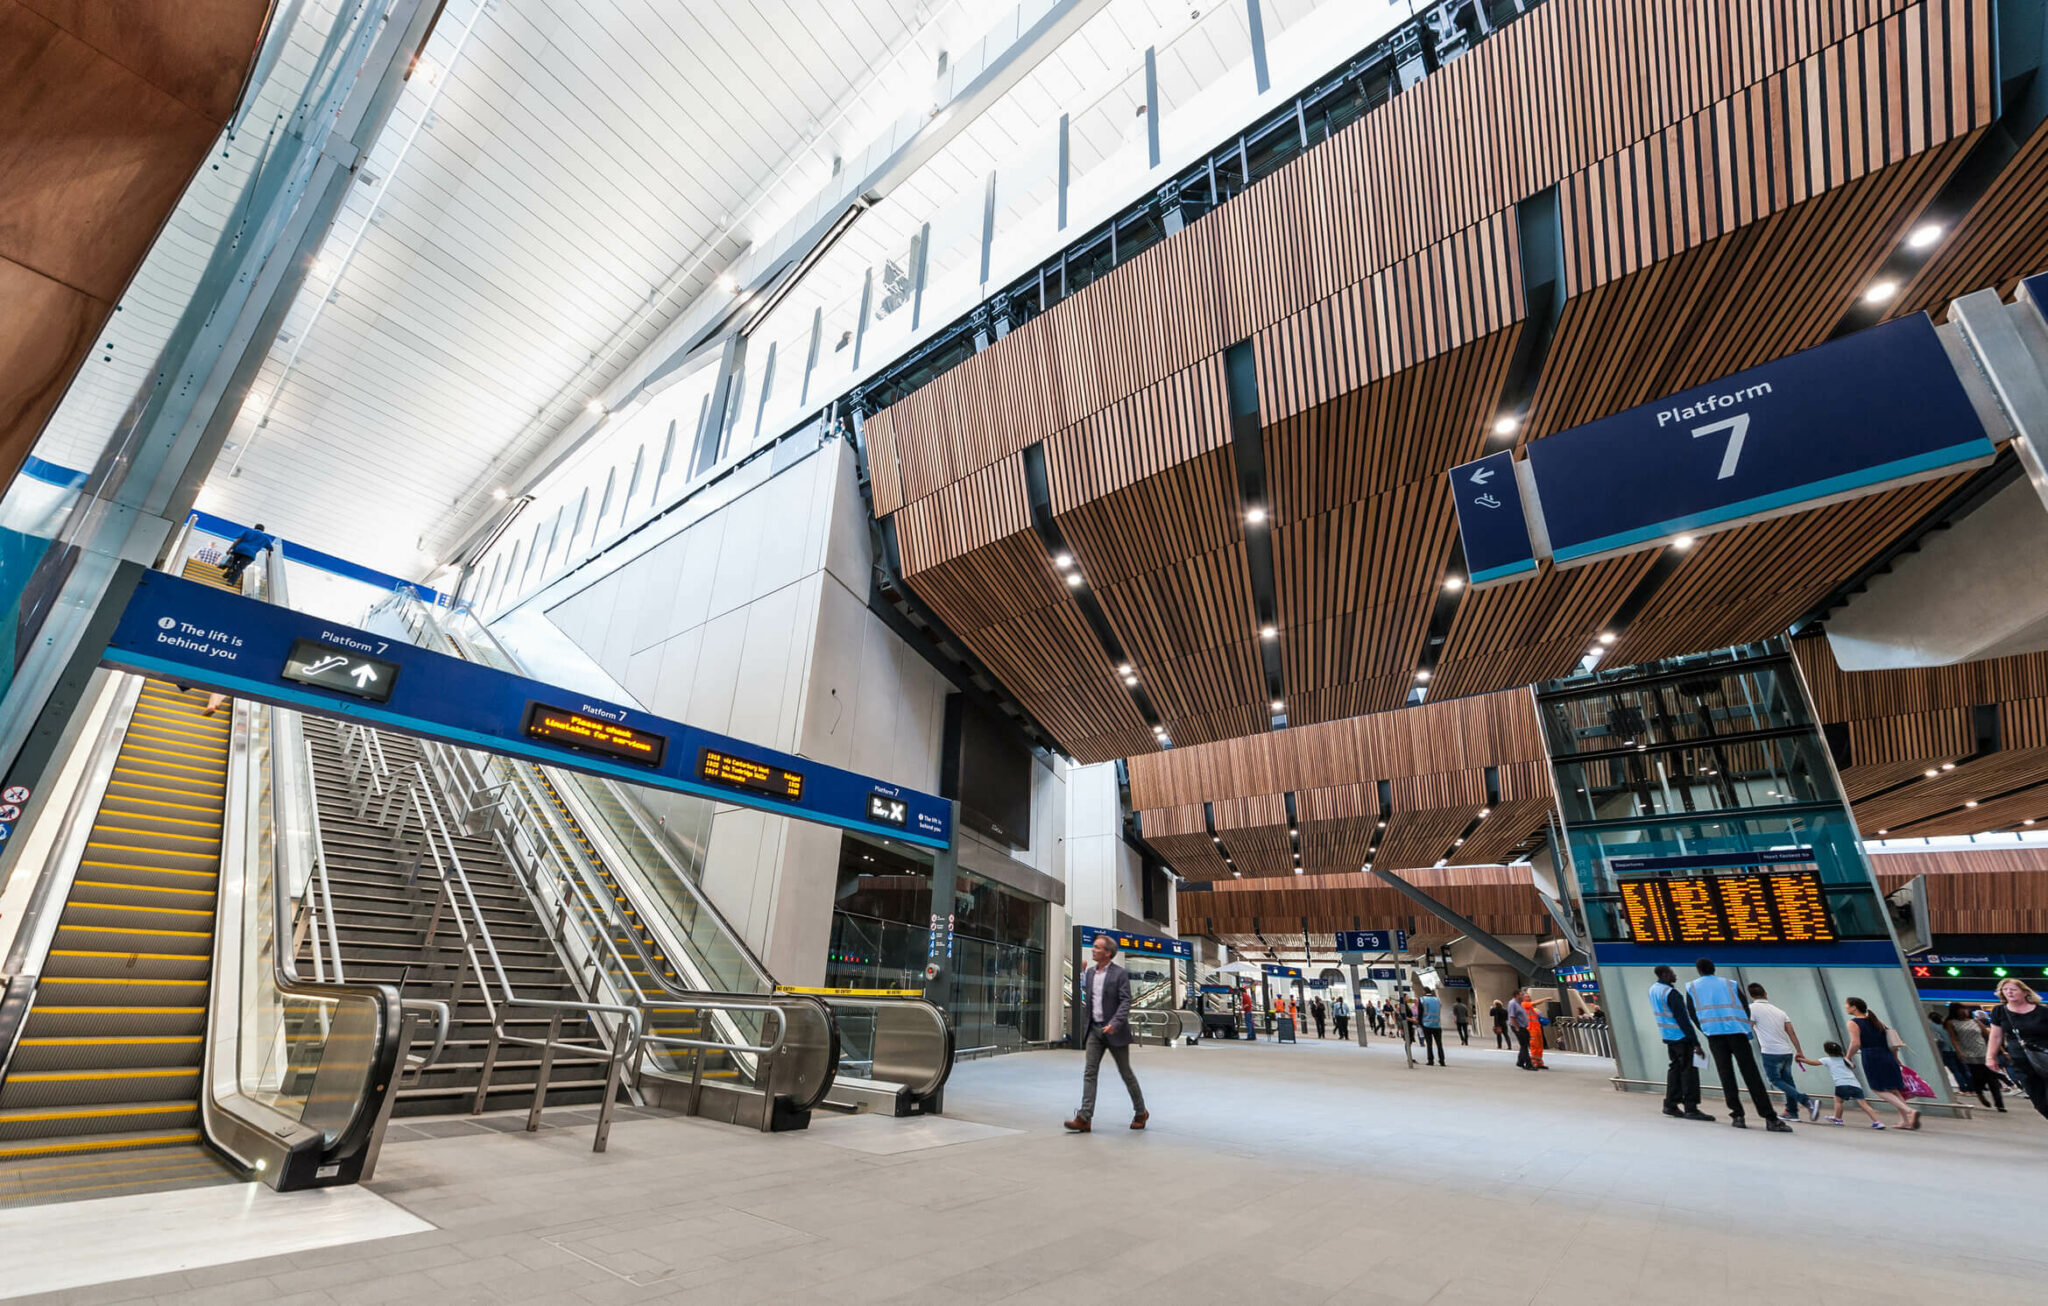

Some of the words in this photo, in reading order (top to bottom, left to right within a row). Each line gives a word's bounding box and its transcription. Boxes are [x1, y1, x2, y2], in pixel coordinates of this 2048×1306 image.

[1656, 381, 1773, 427] Platform
[1691, 412, 1750, 480] 7
[157, 632, 209, 653] behind
[209, 646, 238, 660] you
[180, 622, 206, 637] The
[208, 629, 229, 645] lift
[231, 636, 243, 647] is
[321, 631, 373, 652] Platform
[376, 642, 389, 654] 7
[582, 704, 616, 720] Platform
[619, 711, 628, 722] 7
[545, 718, 591, 736] timetable
[593, 731, 609, 740] for
[612, 736, 652, 751] services
[571, 716, 603, 730] Please
[605, 725, 633, 738] check
[874, 785, 894, 795] Platform
[894, 788, 899, 797] 7
[1357, 937, 1364, 947] 8
[1371, 936, 1379, 947] 9
